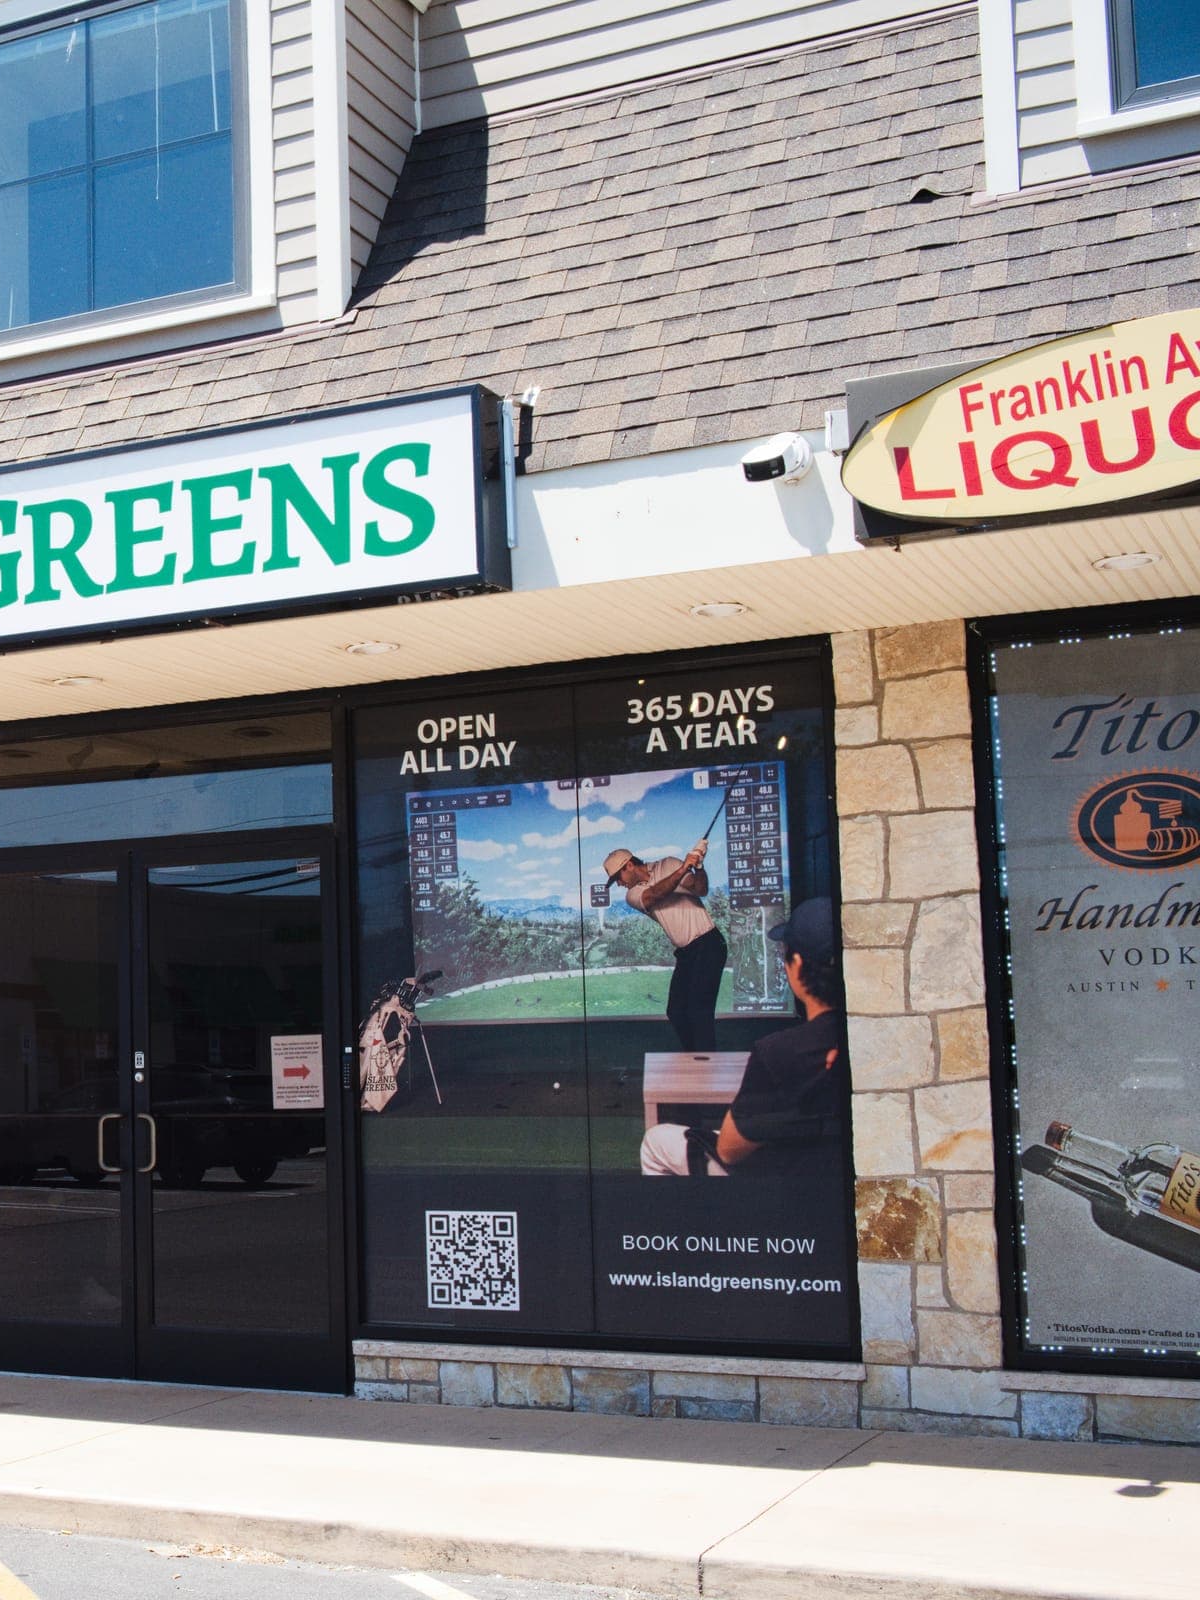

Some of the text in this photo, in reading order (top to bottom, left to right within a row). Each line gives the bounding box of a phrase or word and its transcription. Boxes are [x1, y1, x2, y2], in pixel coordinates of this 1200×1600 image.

[959, 331, 1200, 433] Franklin A
[627, 684, 775, 725] 365 DAYS
[417, 712, 496, 744] OPEN
[645, 718, 758, 754] A YEAR
[400, 740, 517, 776] ALL DAY
[1066, 980, 1141, 993] AUSTIN
[622, 1234, 816, 1255] BOOK ONLINE NOW
[609, 1271, 842, 1293] www.islandgreensny.com
[1053, 1323, 1195, 1338] TitosVodka.com Crafted to
